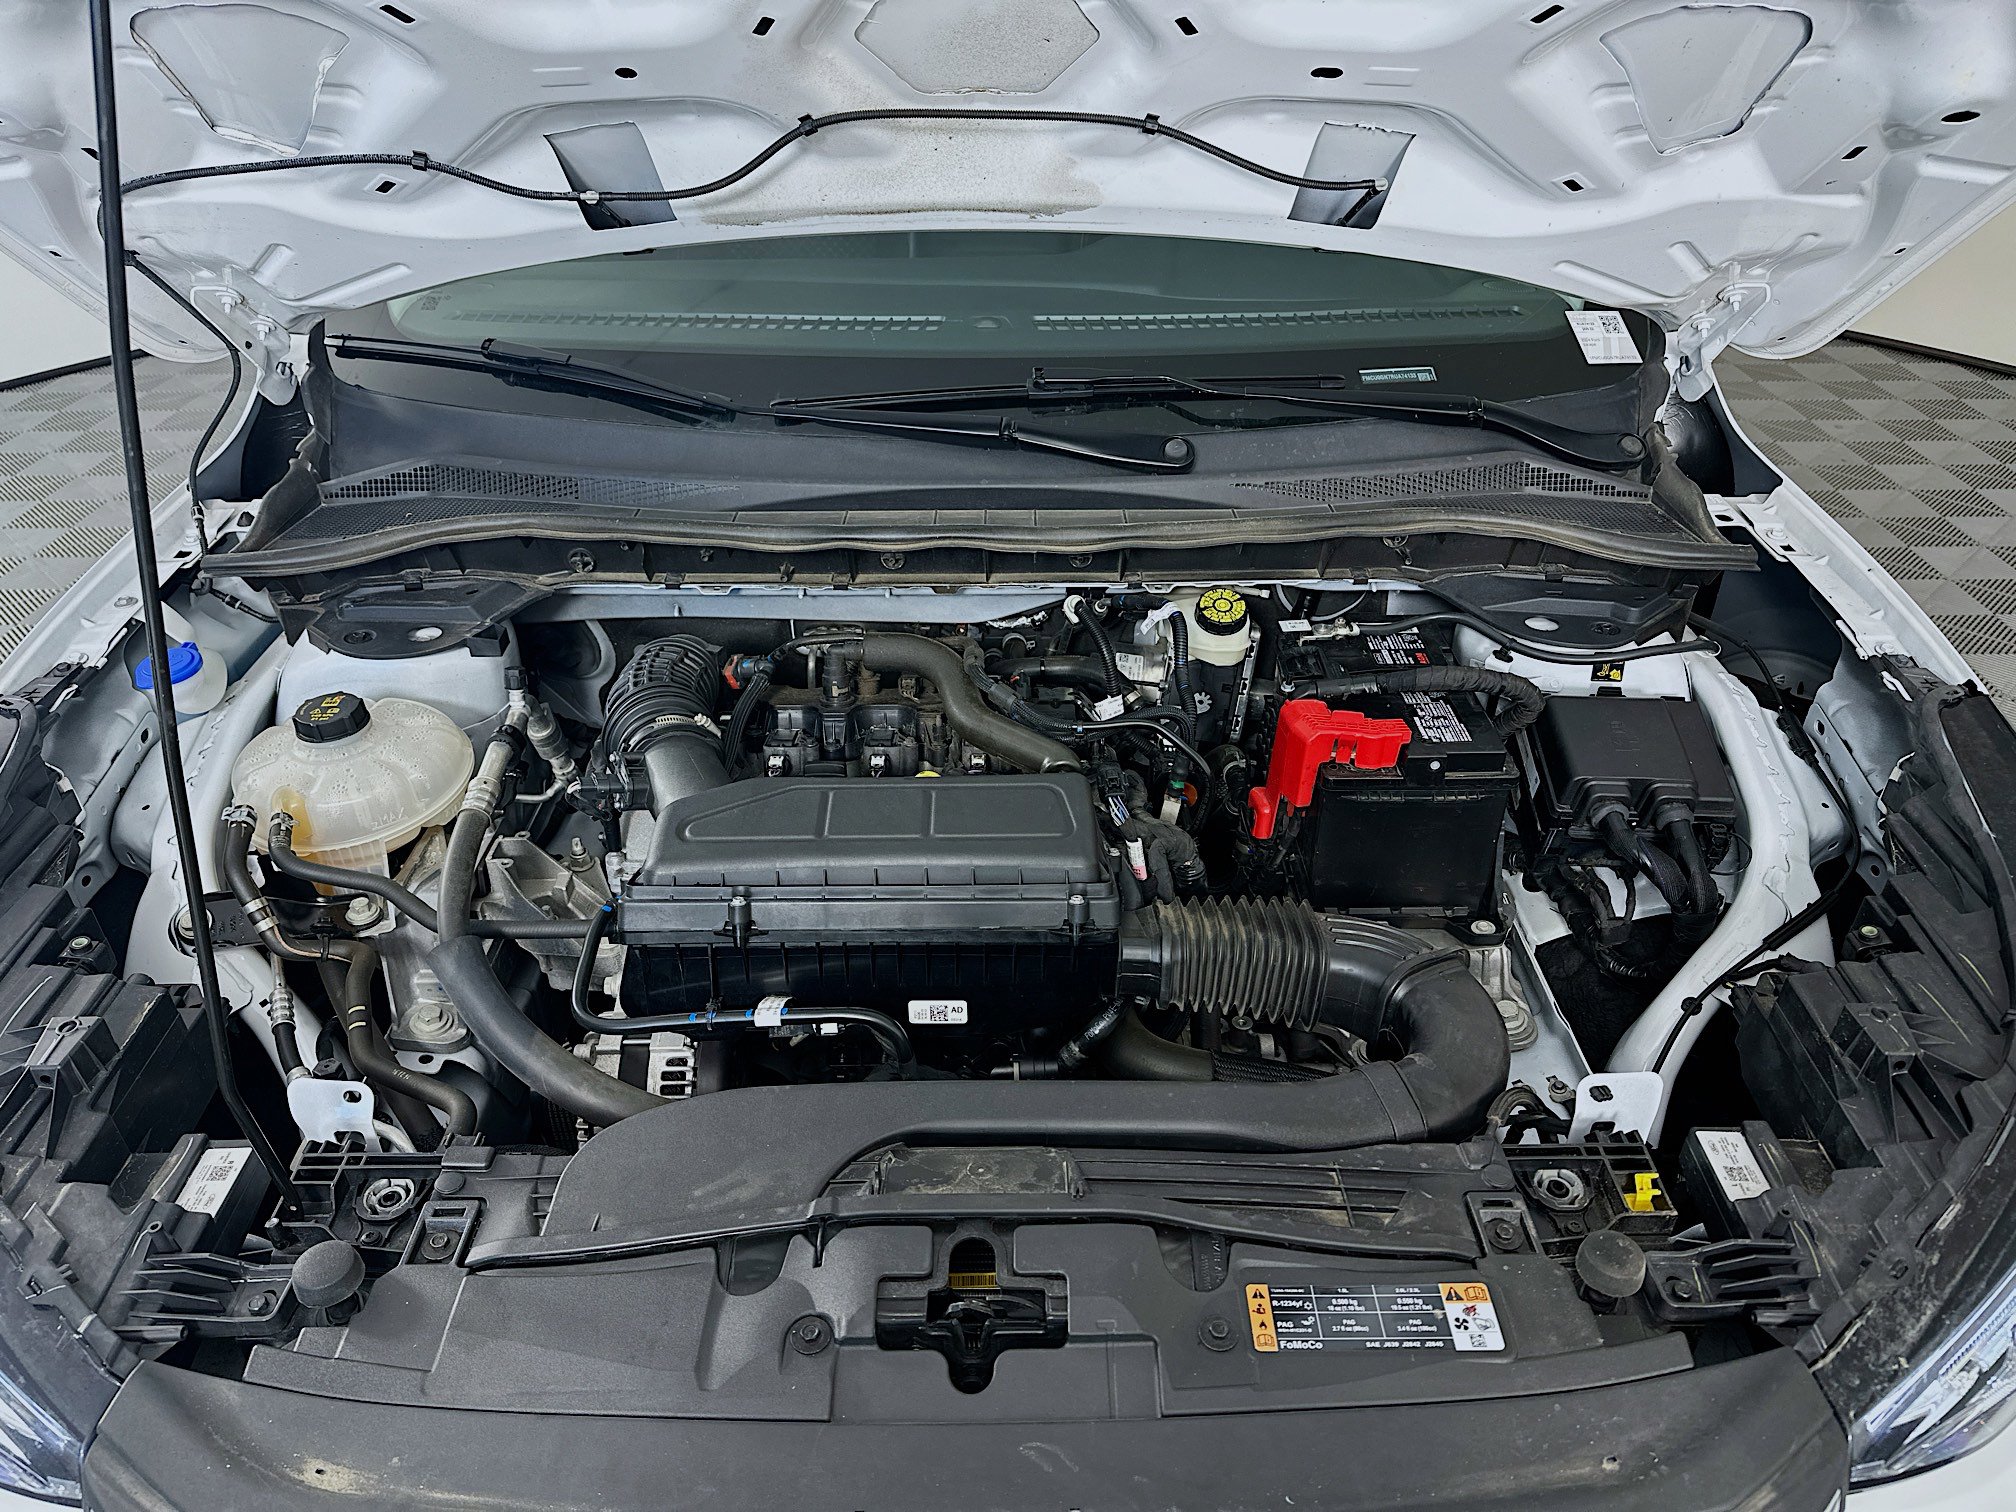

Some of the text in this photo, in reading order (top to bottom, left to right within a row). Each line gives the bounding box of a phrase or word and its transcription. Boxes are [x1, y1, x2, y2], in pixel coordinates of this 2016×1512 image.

[951, 1006, 964, 1014] AD
[1272, 1300, 1303, 1308] R-1234yf
[1280, 1341, 1323, 1349] FoMoCo
